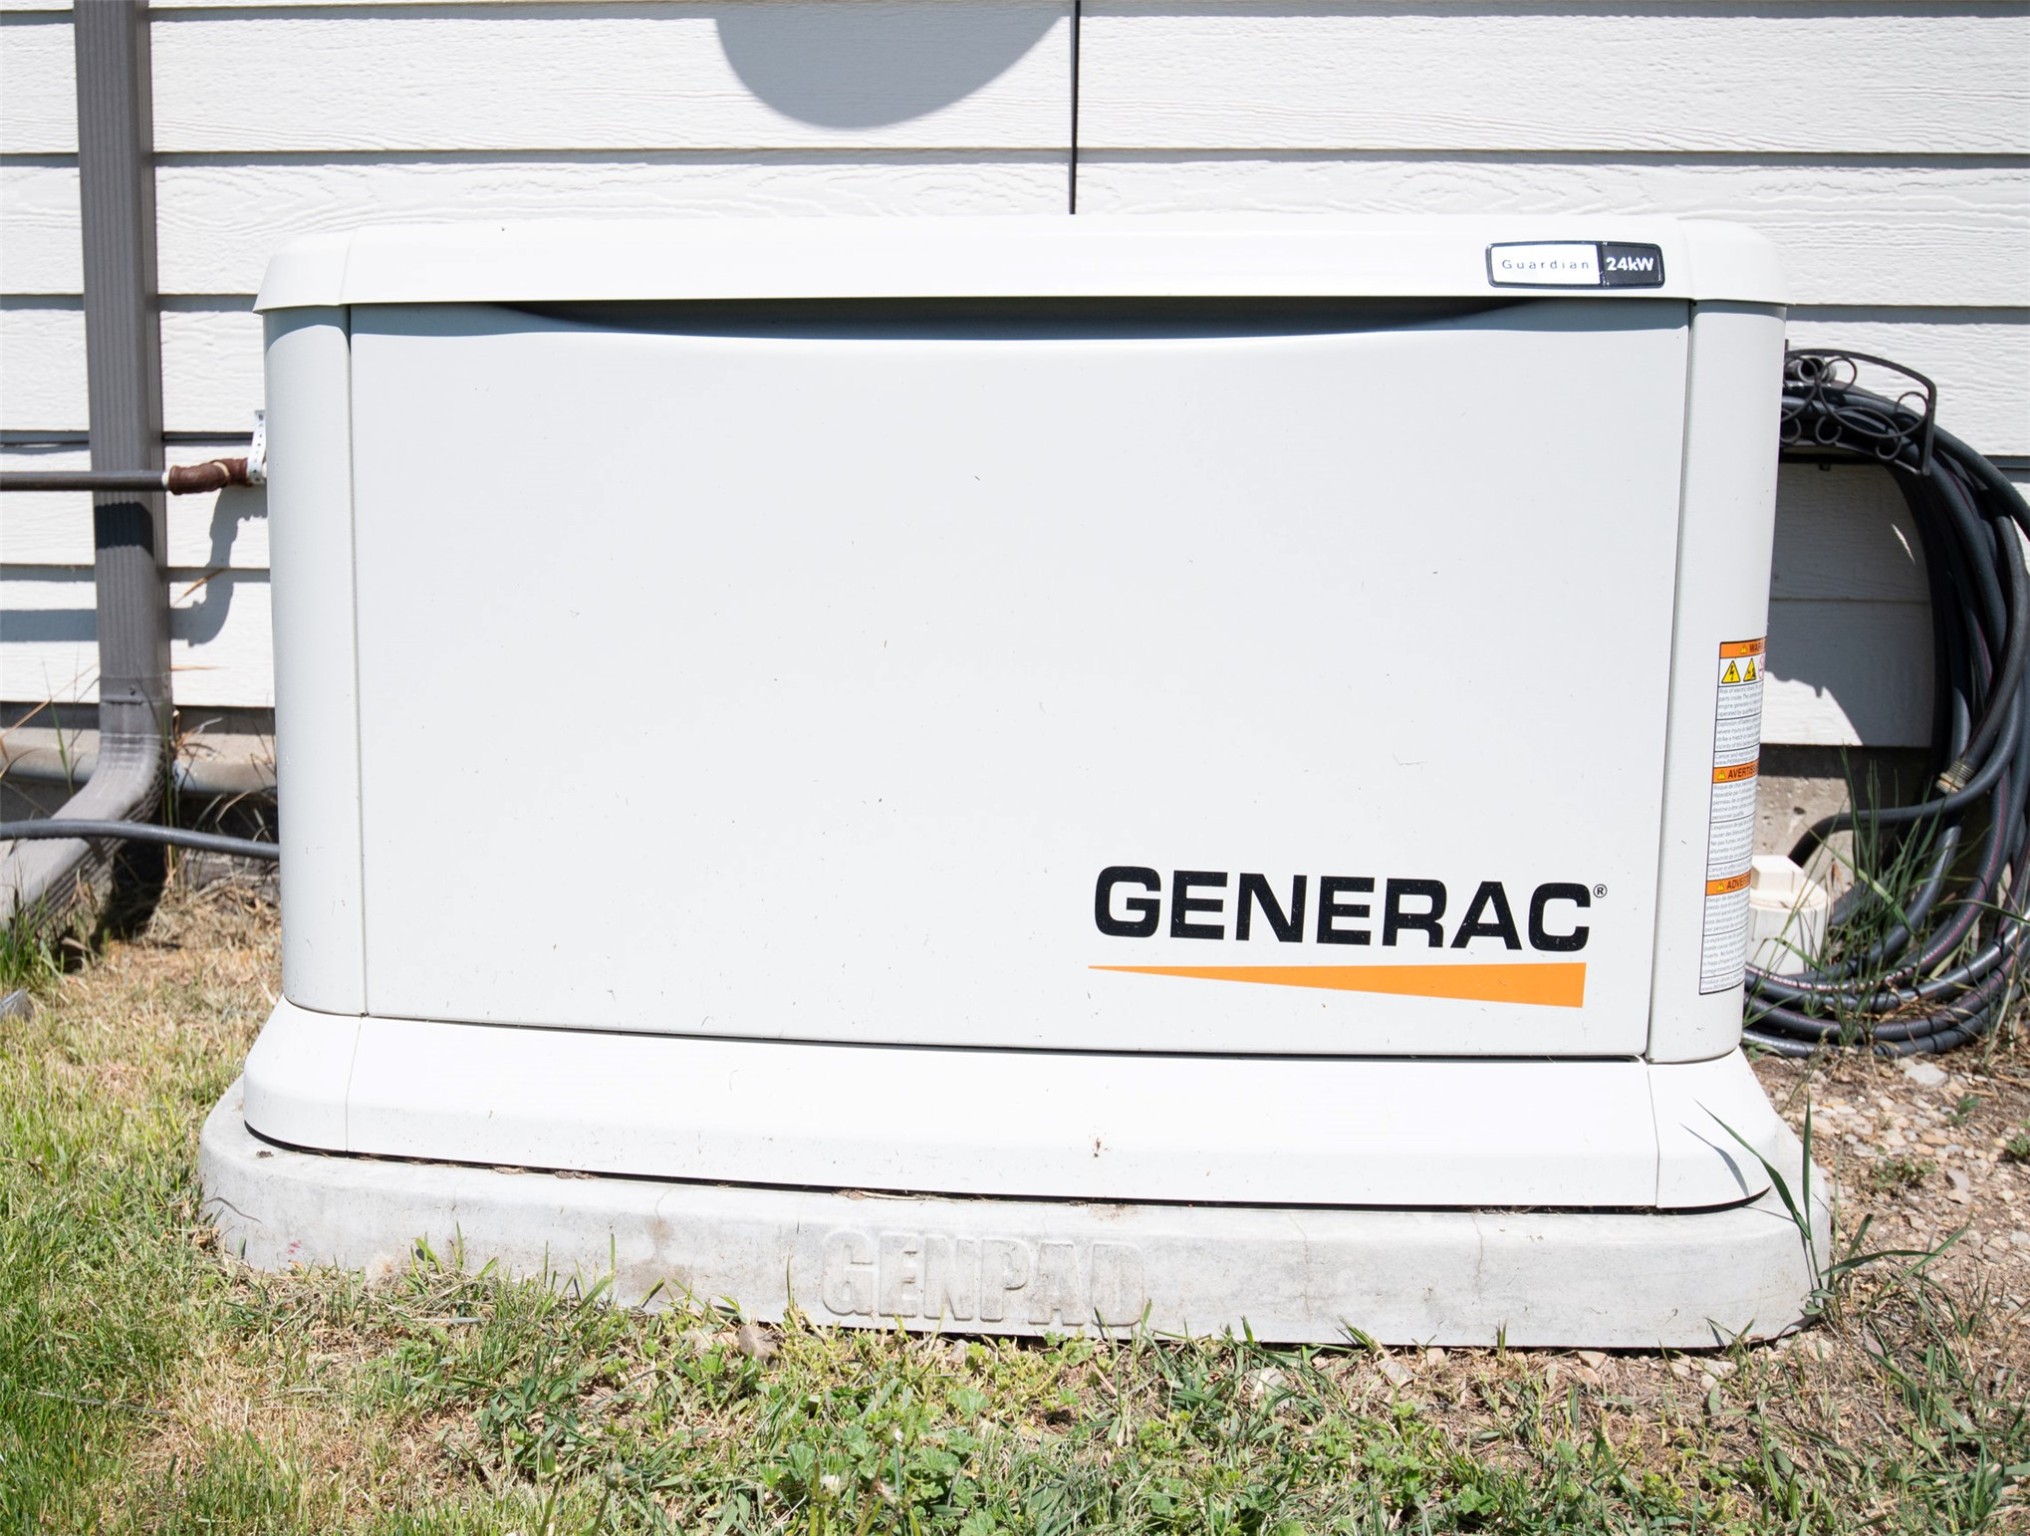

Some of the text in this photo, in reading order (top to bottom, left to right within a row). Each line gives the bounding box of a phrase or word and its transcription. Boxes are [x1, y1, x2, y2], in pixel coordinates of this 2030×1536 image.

[1501, 256, 1654, 272] Guardian 24kW
[821, 1229, 1146, 1327] GENPAD
